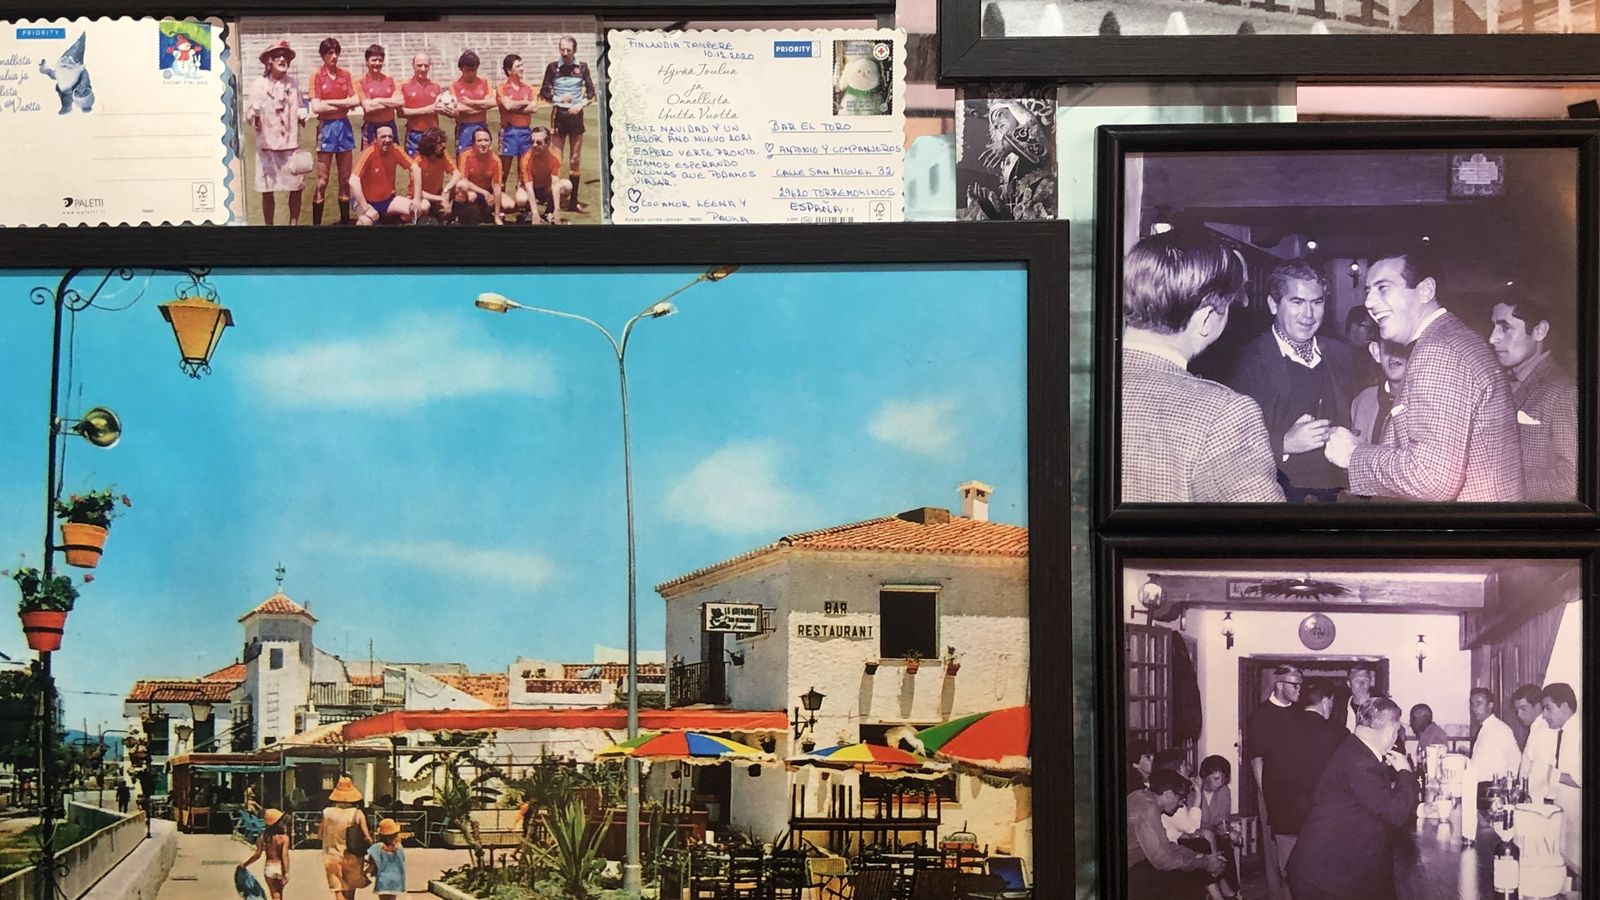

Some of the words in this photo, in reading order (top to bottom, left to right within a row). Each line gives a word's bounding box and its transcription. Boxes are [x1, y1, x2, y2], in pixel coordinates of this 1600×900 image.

[626, 37, 680, 49] FINLANDIA
[683, 40, 733, 50] TAMPERE
[775, 45, 811, 53] PRIORITY
[698, 62, 737, 76] Joulua
[684, 82, 703, 96] ja
[667, 93, 730, 105] Onnellista
[699, 107, 740, 120] Vuotta
[626, 123, 655, 132] FELIZ
[660, 125, 709, 134] NAVIDAD
[713, 124, 720, 133] Y
[768, 120, 797, 132] BAR
[820, 122, 852, 131] TORO
[628, 134, 663, 143] MEJOR
[634, 147, 673, 157] ESPERO
[779, 145, 818, 154] ANTONIO
[822, 144, 829, 154] Y
[626, 158, 670, 168] ESTAMOS
[675, 160, 738, 169] ESPERANDO
[681, 171, 706, 179] QUE
[776, 168, 805, 176] CALLE
[809, 168, 829, 176] SAN
[833, 167, 872, 176] MIGUEL
[878, 166, 895, 176] 32
[812, 188, 896, 197] TORREMOLINOS
[75, 198, 104, 207] PALETTI
[641, 200, 658, 208] CON
[662, 201, 690, 209] AMOR
[739, 199, 747, 207] Y
[824, 601, 847, 614] BAR
[798, 624, 873, 637] RESTAURANT
